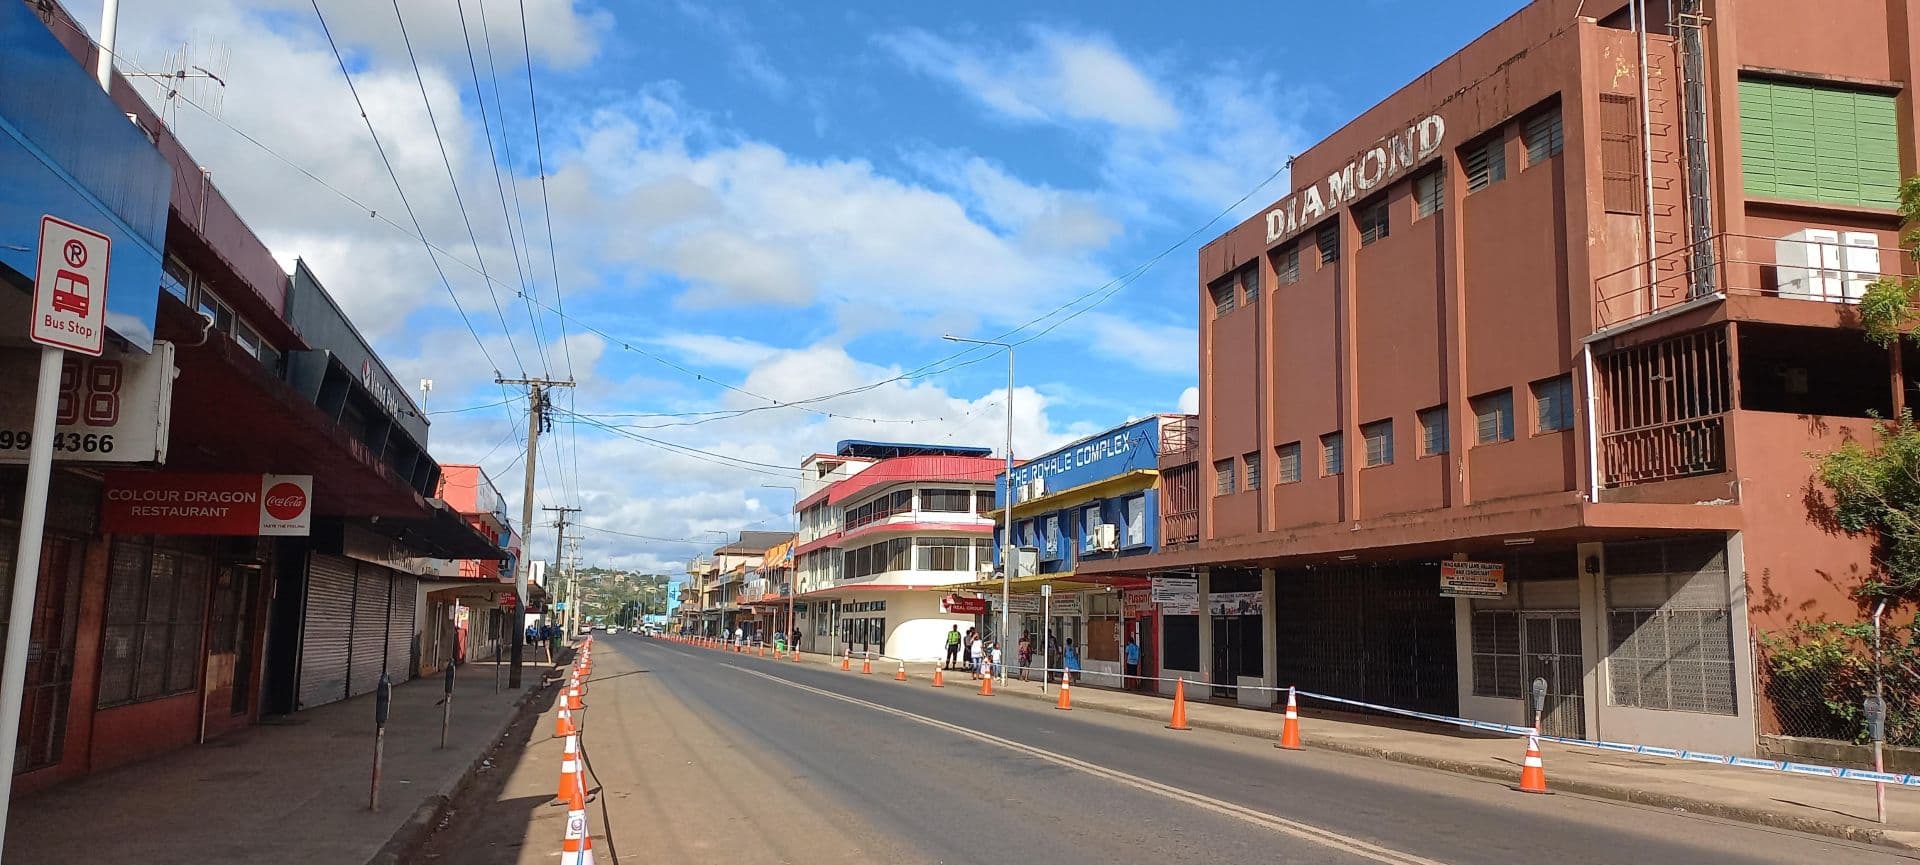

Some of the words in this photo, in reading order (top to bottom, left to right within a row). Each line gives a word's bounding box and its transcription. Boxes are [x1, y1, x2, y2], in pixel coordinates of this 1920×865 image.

[1266, 113, 1446, 245] DIAMOND
[44, 314, 65, 330] Bus
[68, 320, 92, 339] Stop
[0, 430, 114, 453] 994366
[1010, 469, 1028, 487] THE
[1031, 452, 1072, 480] ROYALE
[1076, 431, 1130, 467] COMPLEX
[107, 488, 180, 502] COLOUR
[184, 490, 257, 503] DRAGON
[131, 505, 230, 518] RESTAURANT
